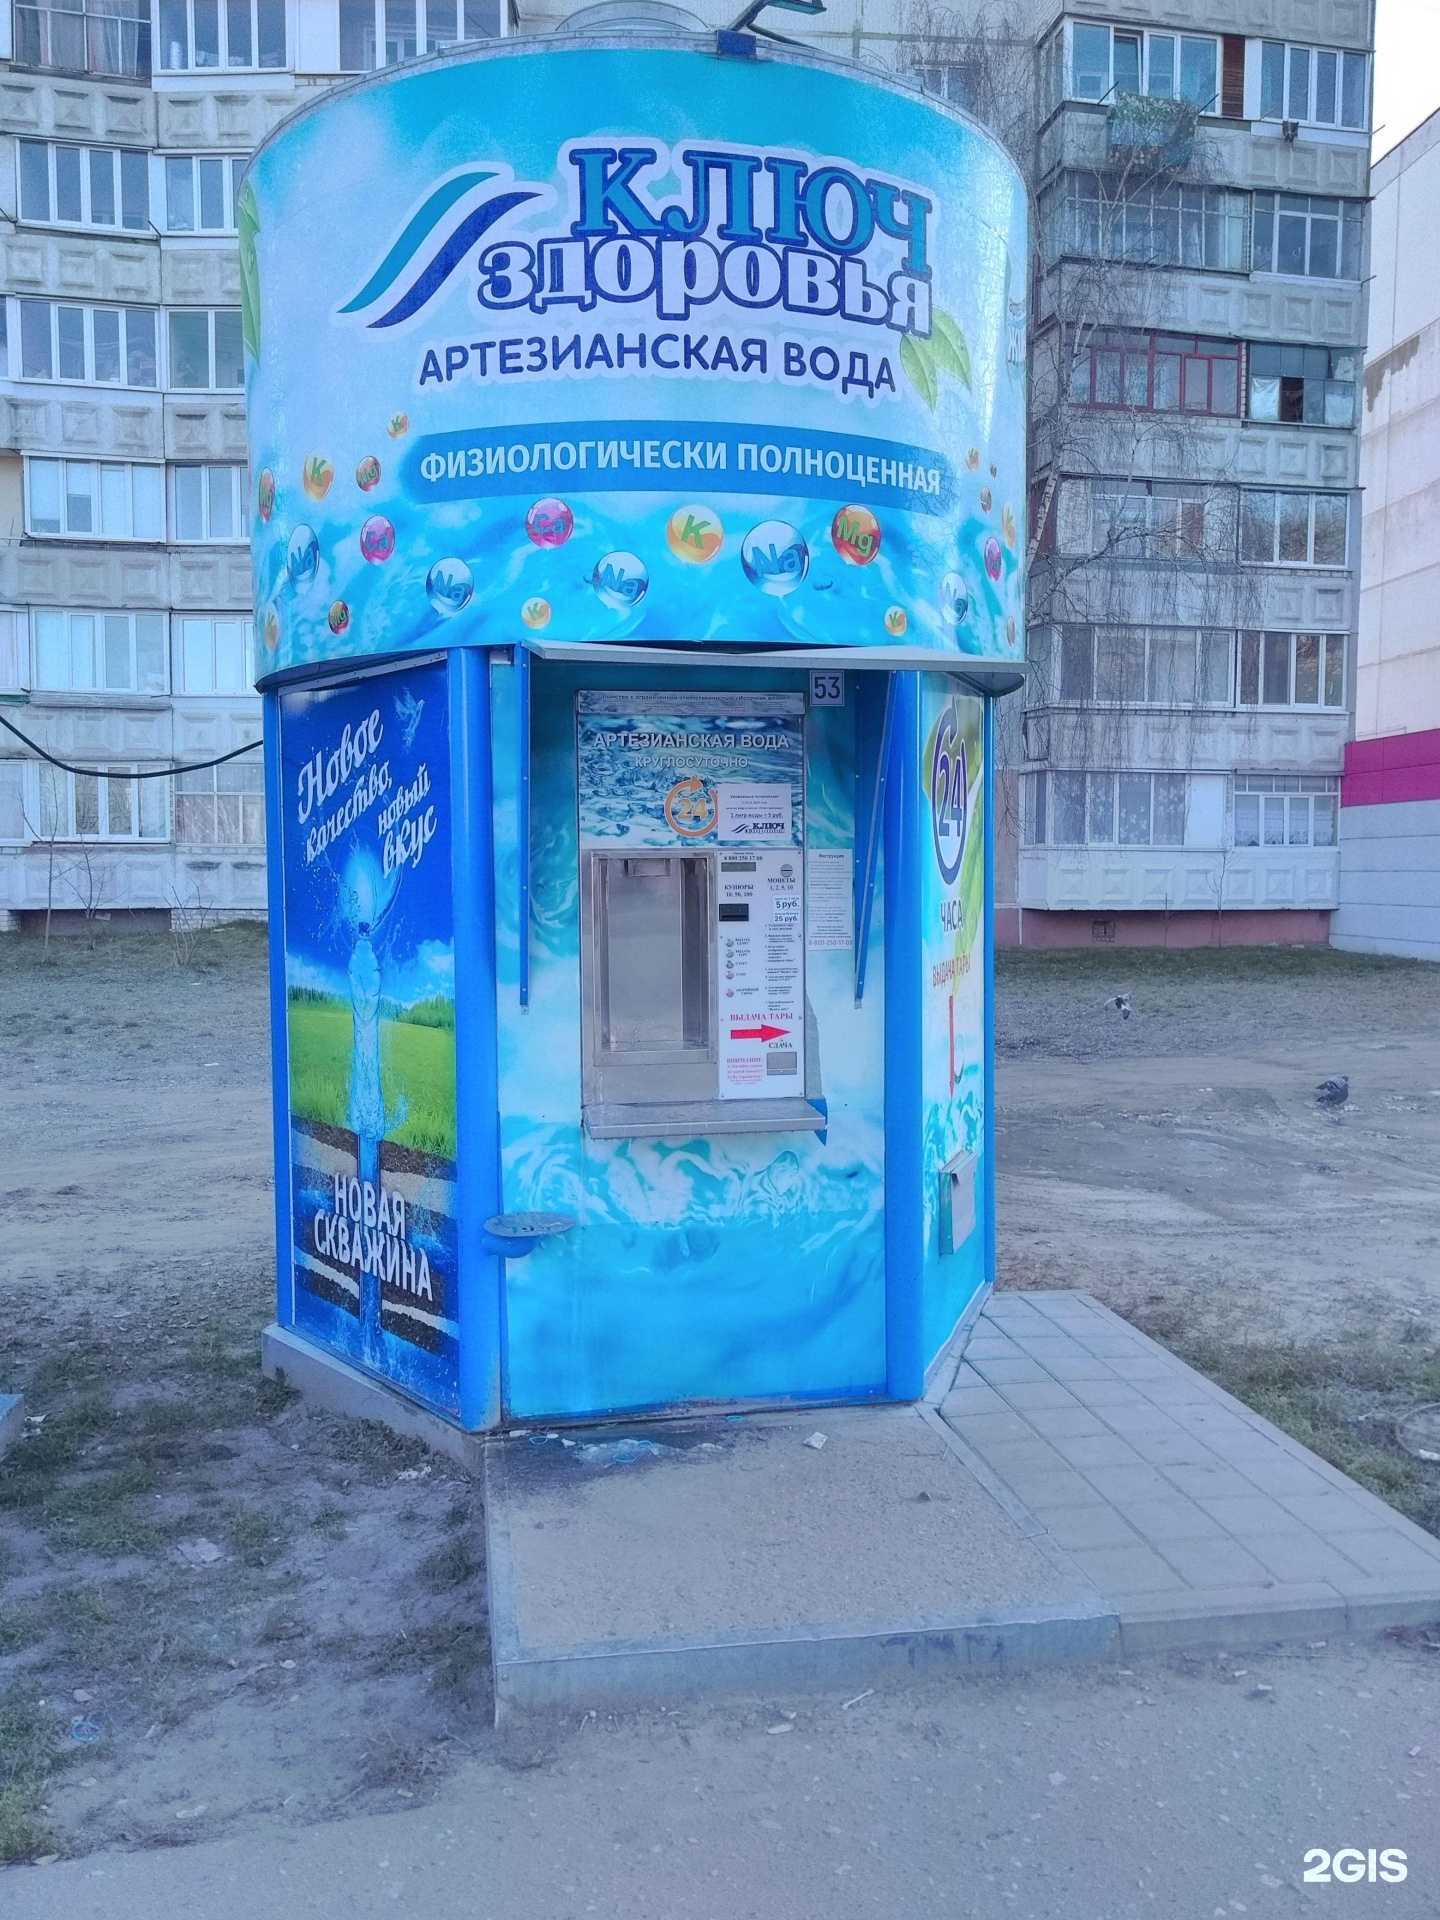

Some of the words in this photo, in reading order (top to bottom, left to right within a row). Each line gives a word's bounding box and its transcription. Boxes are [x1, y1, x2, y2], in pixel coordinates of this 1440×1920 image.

[568, 146, 934, 278] КЛЮЧ
[478, 236, 933, 340] здоровья
[419, 333, 767, 386] АРТЕЗИАНСКАЯ
[783, 342, 897, 399] ВОДА
[420, 438, 727, 484] ФИЗИОЛОГИЧЕСКИ
[737, 444, 941, 495] ПОЛНОЦЕННАЯ
[534, 513, 567, 536] Ca
[680, 514, 711, 549] K
[837, 515, 874, 558] Mg
[290, 546, 314, 576] Na
[752, 543, 802, 576] Na
[435, 569, 466, 600] Na
[602, 562, 641, 595] Na
[814, 676, 841, 699] 53
[594, 732, 735, 750] АРТЕЗИАНСКАЯ
[741, 733, 790, 751] ВОДА
[298, 709, 383, 825] Новое
[633, 755, 749, 769] КРУГЛОСУТОЧНО
[378, 762, 431, 838] новый
[679, 798, 708, 821] 24
[939, 751, 963, 838] 24
[383, 805, 437, 879] вкус
[776, 901, 781, 909] 5
[782, 900, 800, 909] руб.
[940, 899, 965, 932] ЧАСА
[334, 1172, 406, 1240] НОВАЯ
[314, 1208, 433, 1301] СКВАЖИНА
